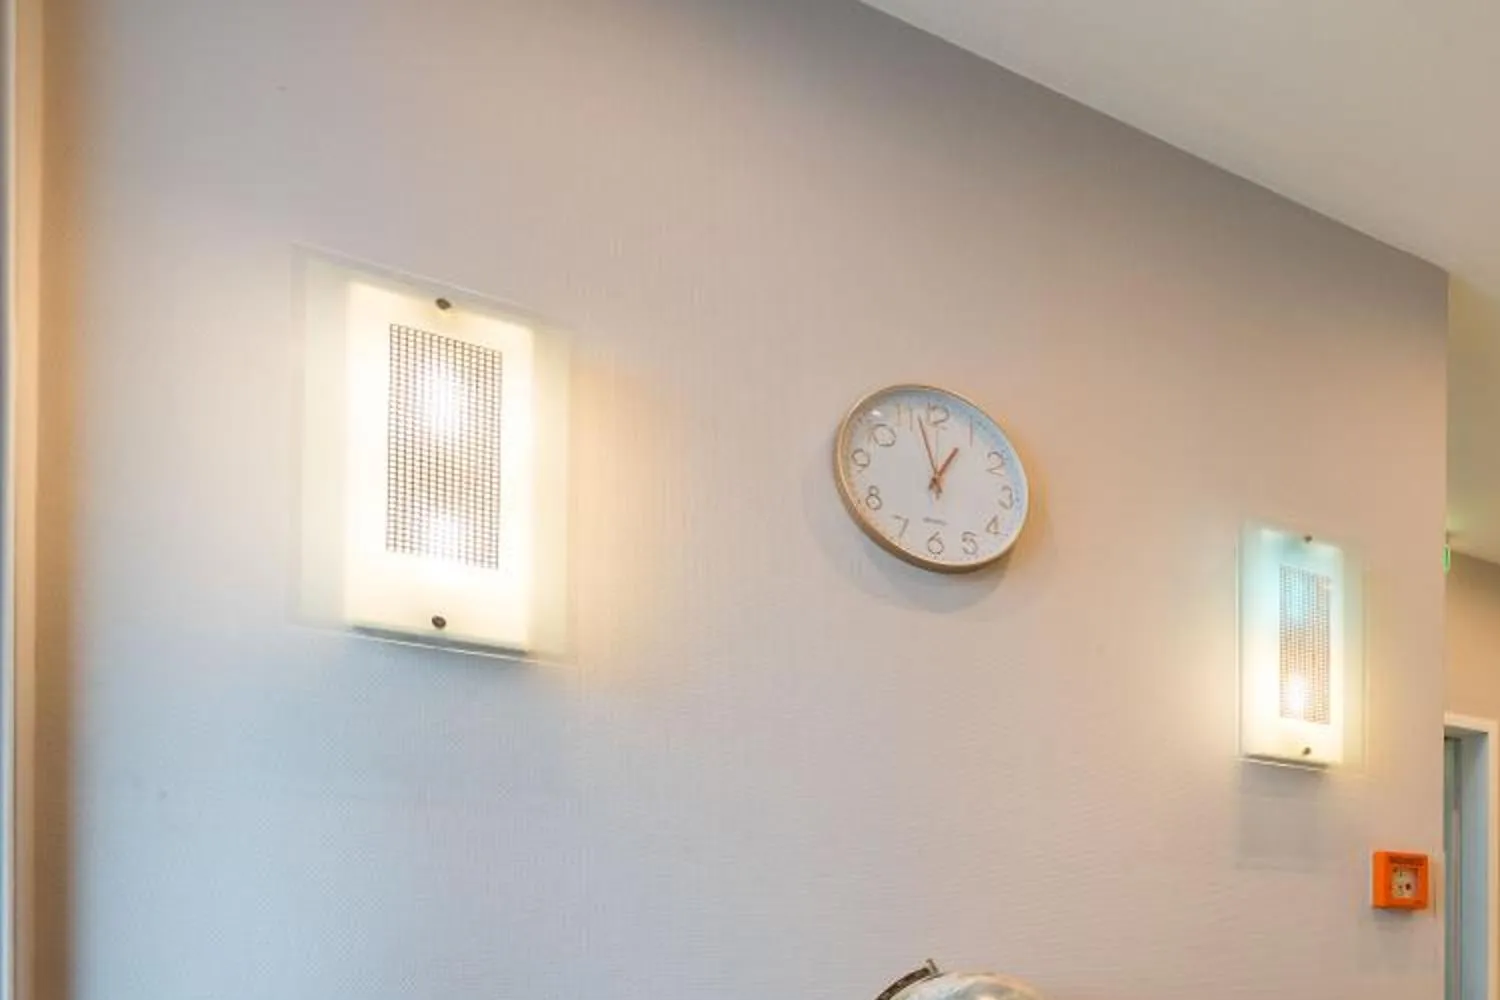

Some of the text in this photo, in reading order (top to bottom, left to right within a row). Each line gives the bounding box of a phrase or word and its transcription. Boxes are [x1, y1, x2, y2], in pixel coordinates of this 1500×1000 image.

[926, 401, 950, 431] 12
[850, 447, 871, 474] 9
[985, 450, 1006, 477] 2
[865, 485, 883, 511] 8
[998, 485, 1014, 510] 3
[892, 514, 910, 539] 7
[985, 515, 1001, 536] 4
[926, 531, 945, 556] 6
[960, 530, 979, 556] 5
